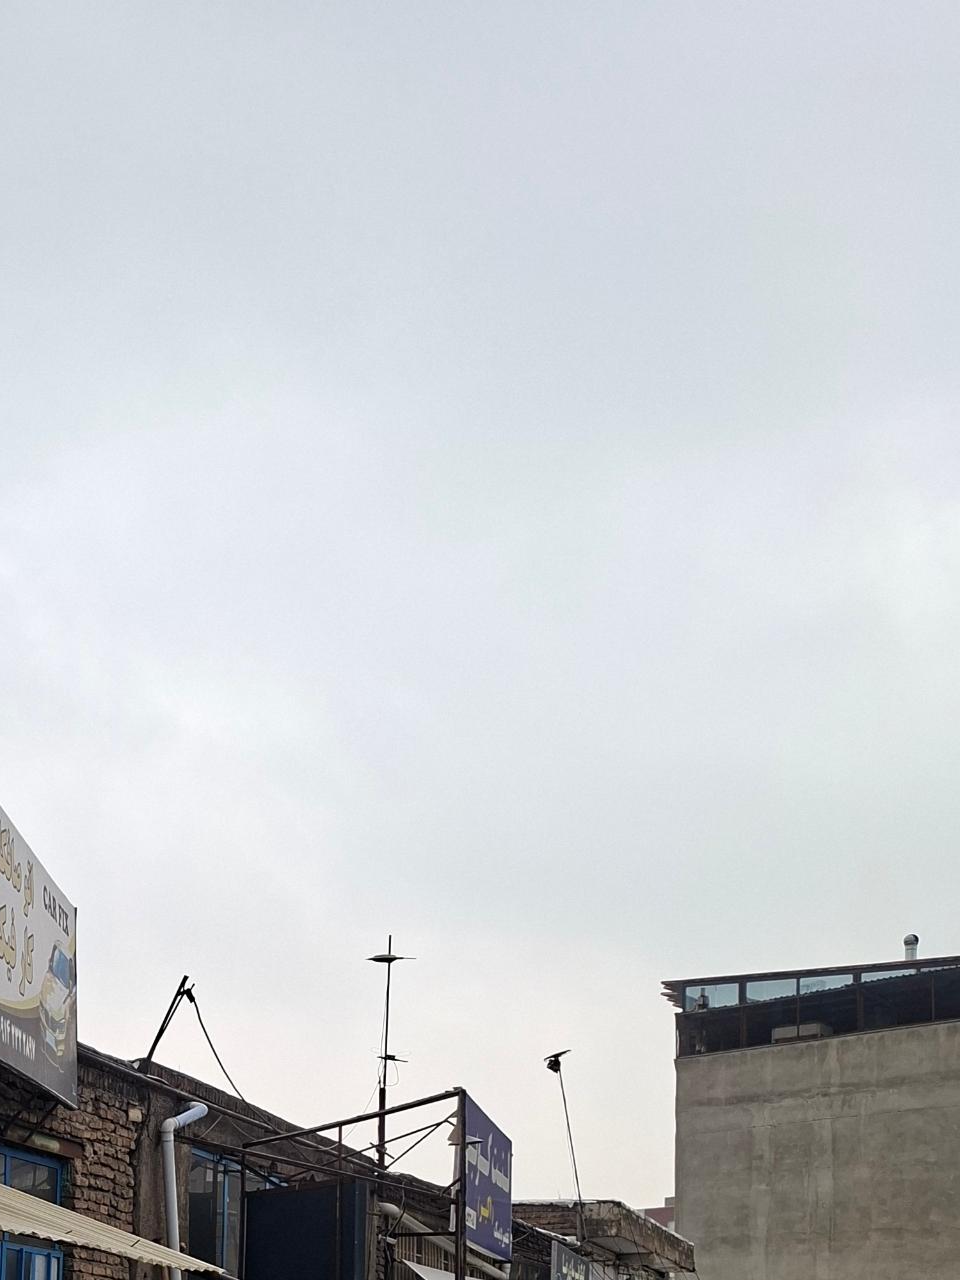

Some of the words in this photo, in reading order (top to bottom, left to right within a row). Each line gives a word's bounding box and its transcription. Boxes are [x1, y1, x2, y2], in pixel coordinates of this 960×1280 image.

[43, 885, 58, 924] CAR
[58, 903, 69, 936] FIX
[19, 925, 35, 997] کار
